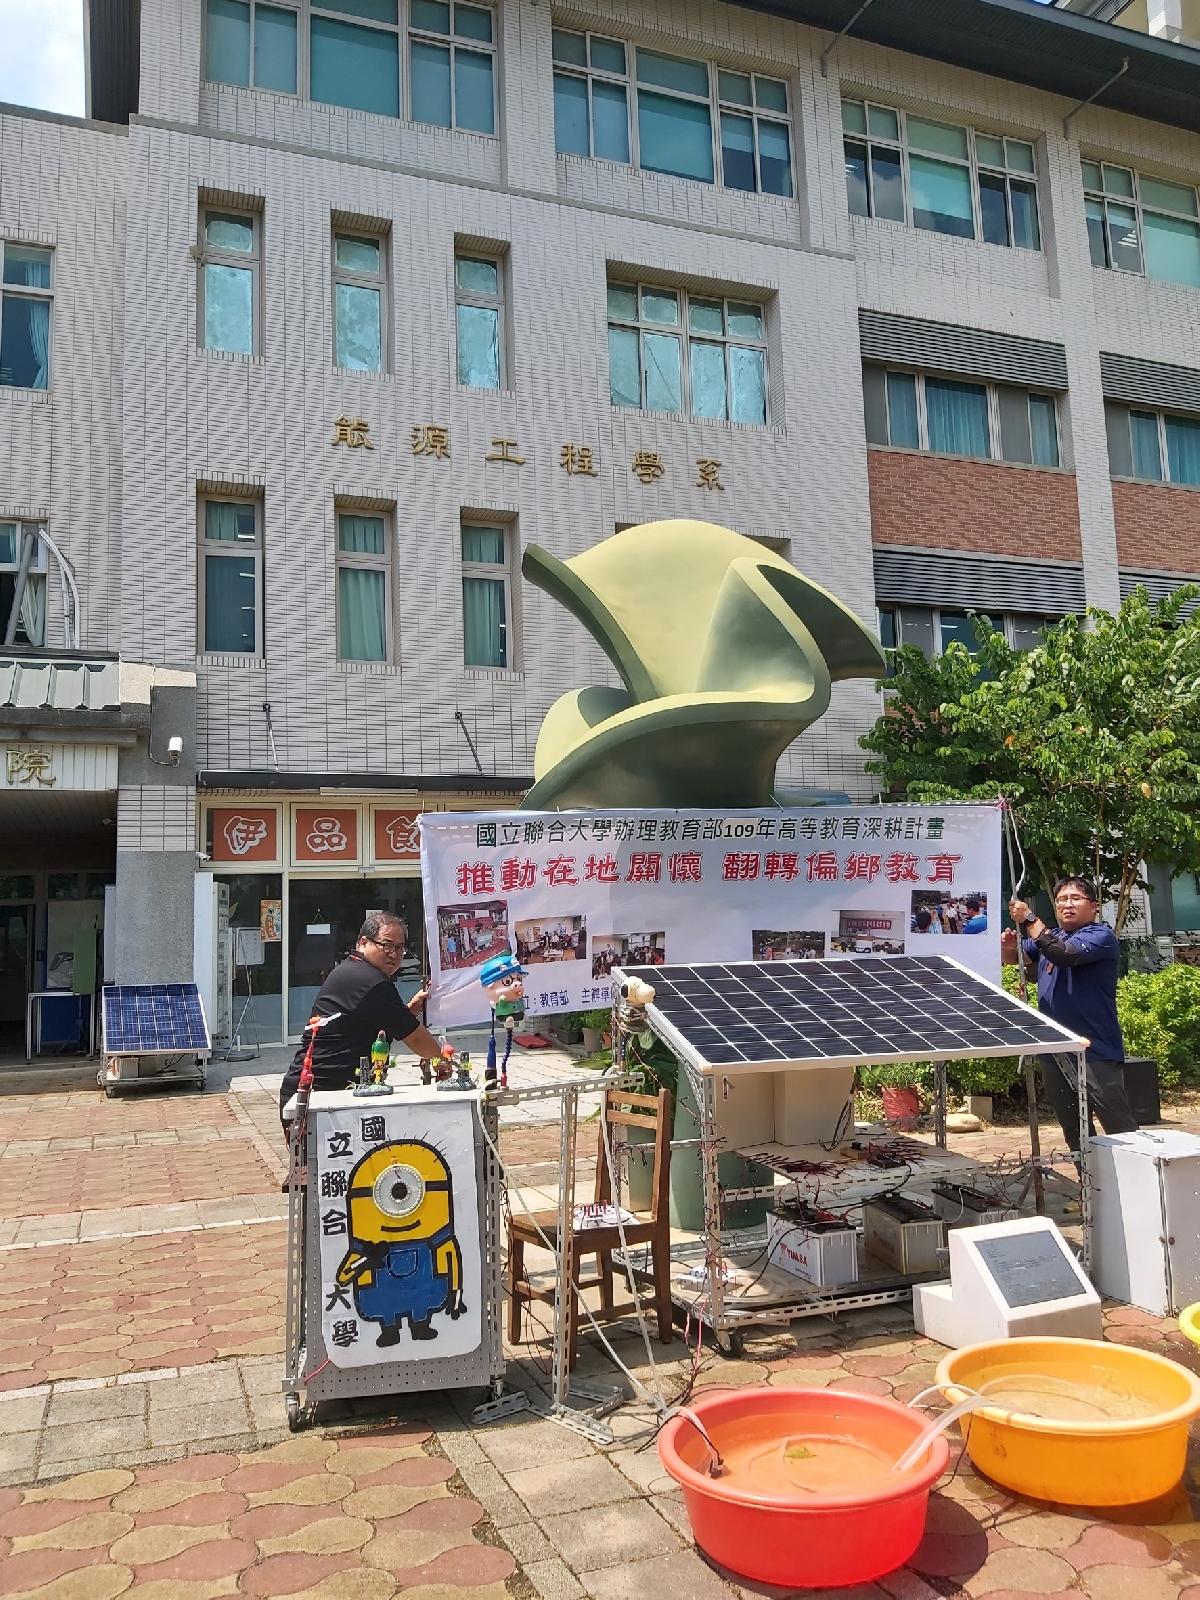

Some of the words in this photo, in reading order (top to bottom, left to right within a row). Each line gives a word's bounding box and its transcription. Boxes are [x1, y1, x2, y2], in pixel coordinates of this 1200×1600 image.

[331, 414, 724, 491] 能源工程學系
[6, 749, 56, 787] 院
[476, 816, 945, 848] 國立聯合大學辦理教育部109年高等教育深耕計畫
[455, 851, 704, 895] 推動在地關懷
[721, 851, 962, 884] 翻轉偏鄉教育
[582, 987, 612, 1004] 主辦單
